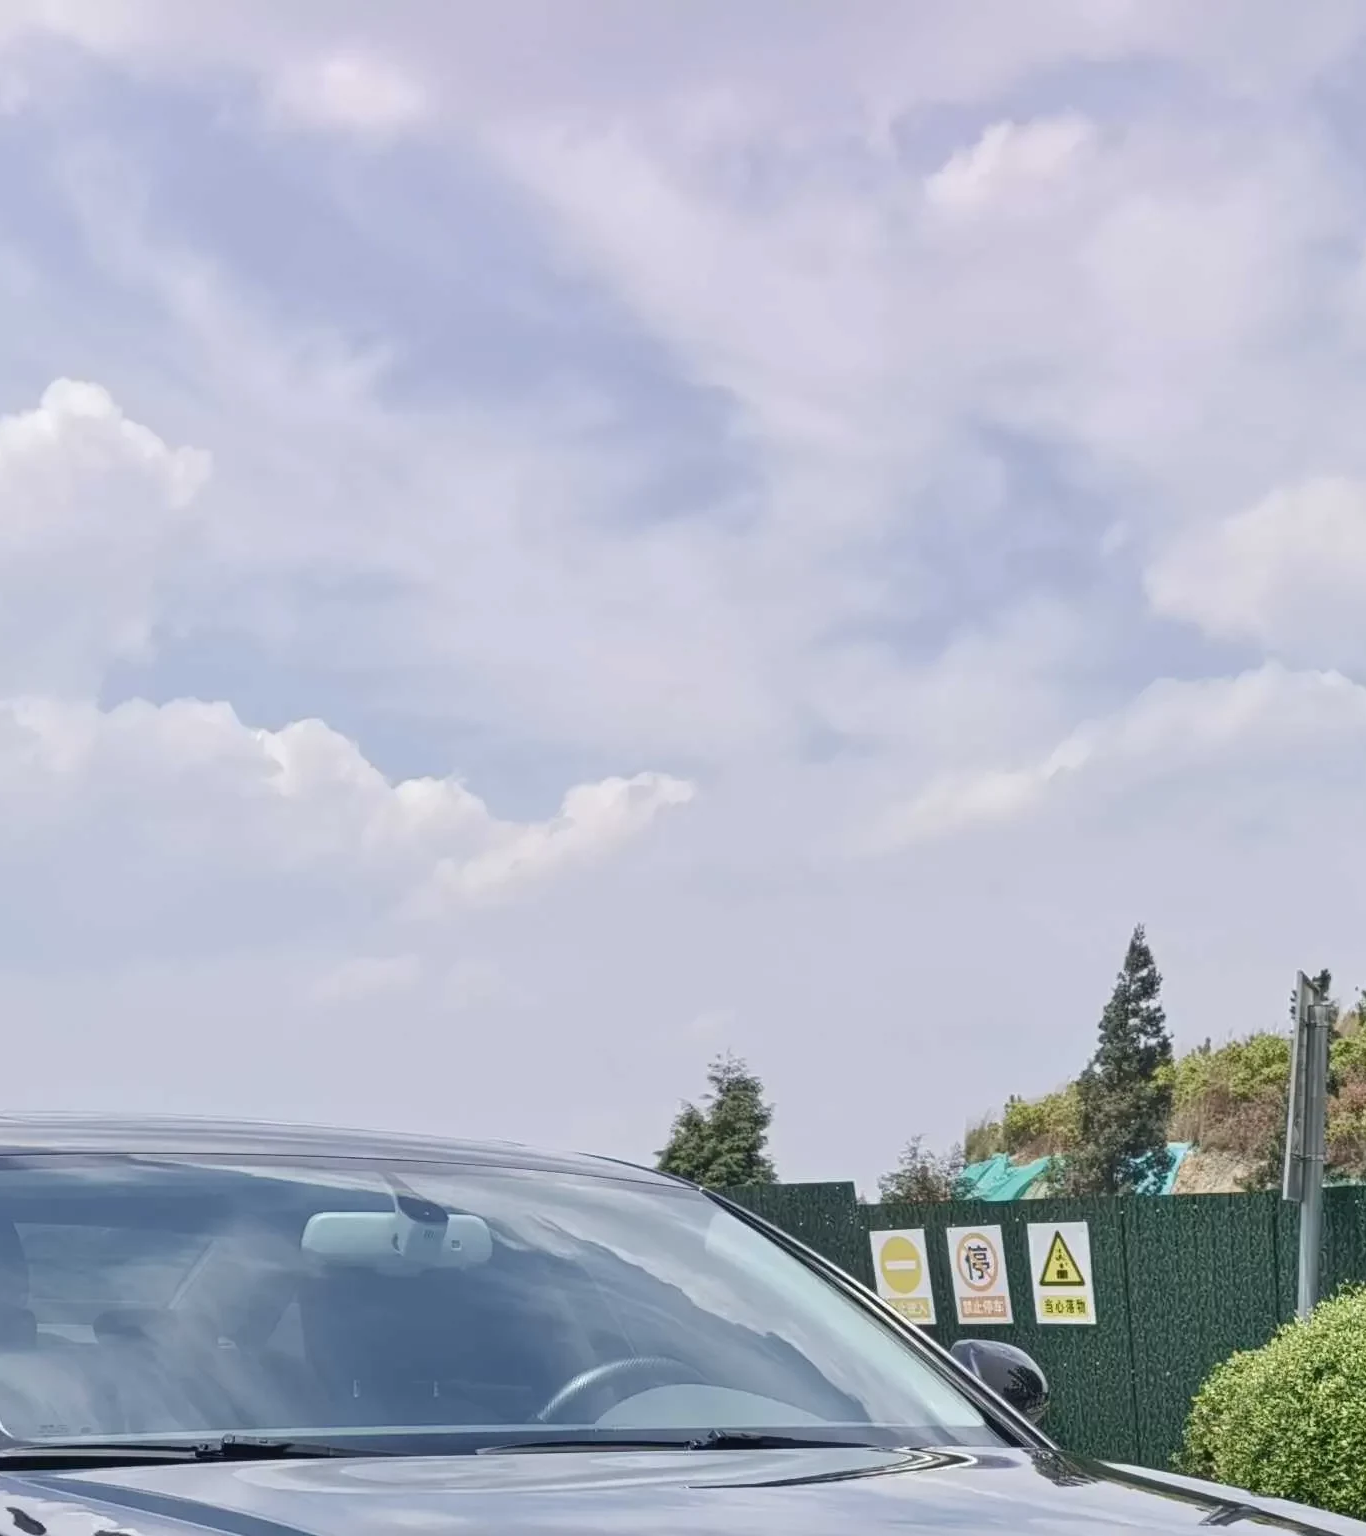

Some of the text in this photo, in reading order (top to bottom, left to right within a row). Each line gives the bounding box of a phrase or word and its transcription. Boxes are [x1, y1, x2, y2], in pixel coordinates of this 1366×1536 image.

[965, 1245, 990, 1280] 停
[1044, 1298, 1086, 1314] 当心落物
